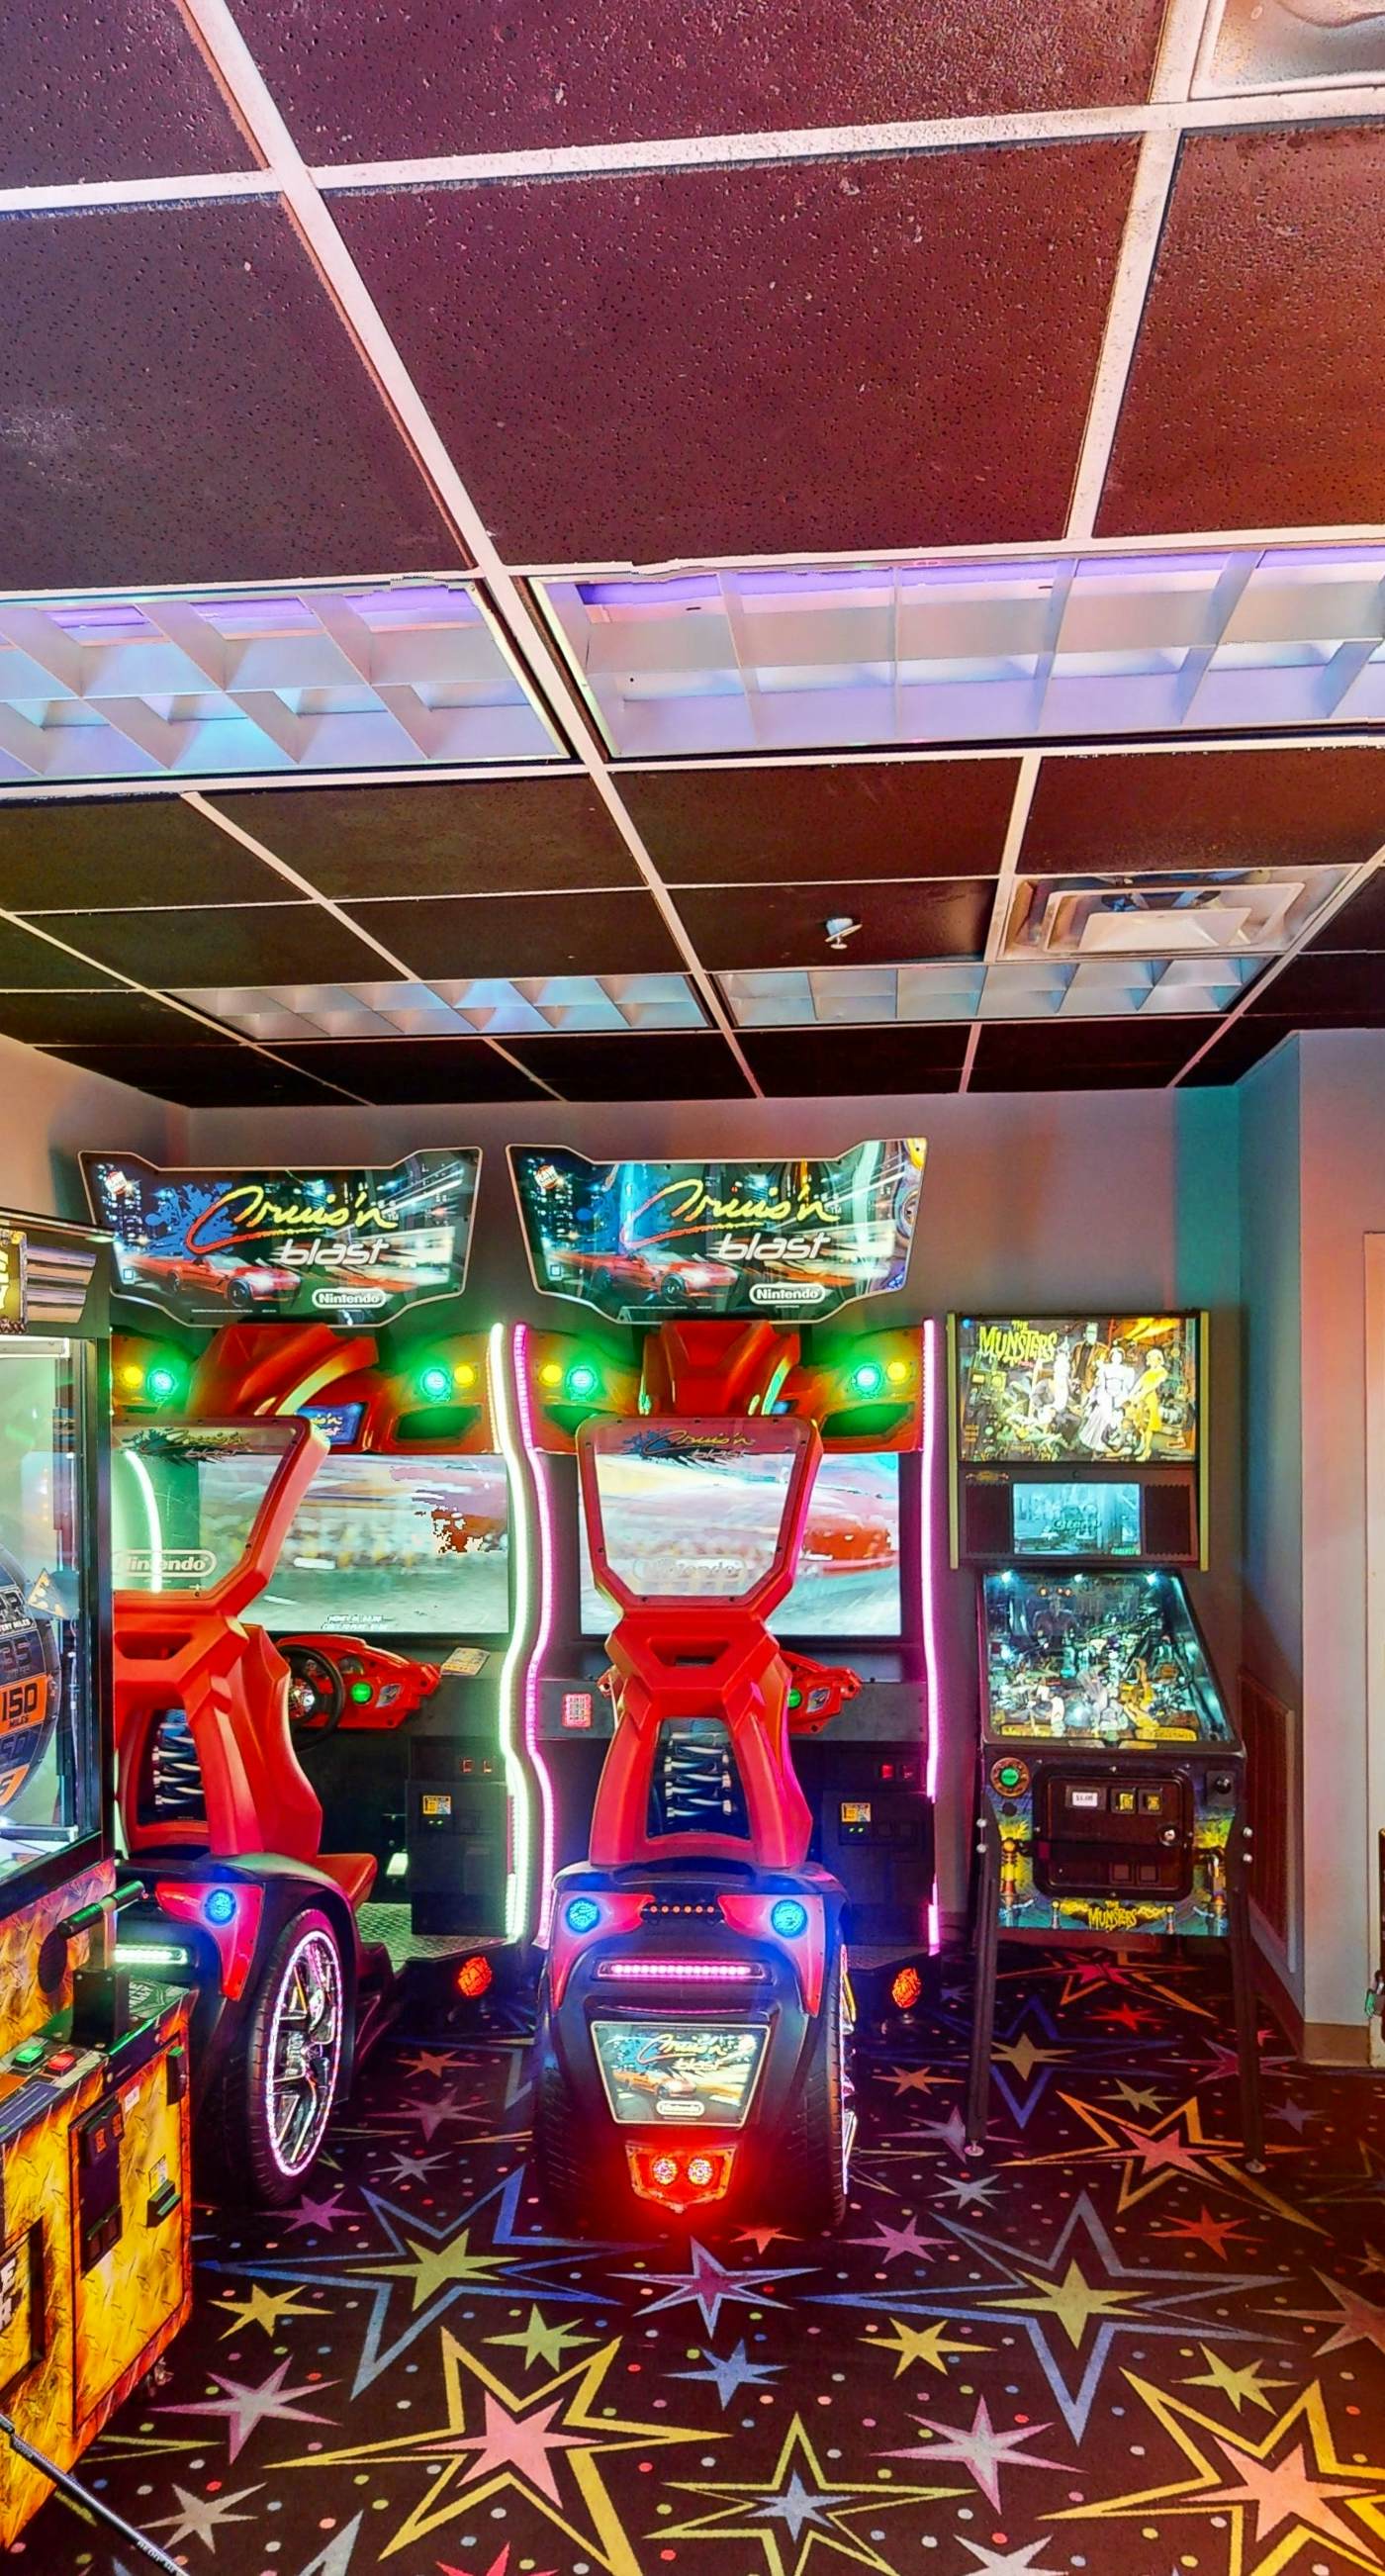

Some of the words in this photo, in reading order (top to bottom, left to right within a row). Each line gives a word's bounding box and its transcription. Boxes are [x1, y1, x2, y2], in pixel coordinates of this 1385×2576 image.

[186, 1185, 399, 1254] Cruis'n
[619, 1178, 840, 1249] Cruis'n
[276, 1238, 390, 1266] blast
[714, 1232, 831, 1261] blast
[319, 1292, 380, 1306] Nintendo
[756, 1288, 819, 1301] Nintendo
[1011, 1320, 1029, 1331] THE
[979, 1326, 1058, 1365] MUNSTERS
[640, 1428, 755, 1455] Cruis'n
[2, 1682, 39, 1721] 150
[1088, 1907, 1138, 1931] MUNSTERS
